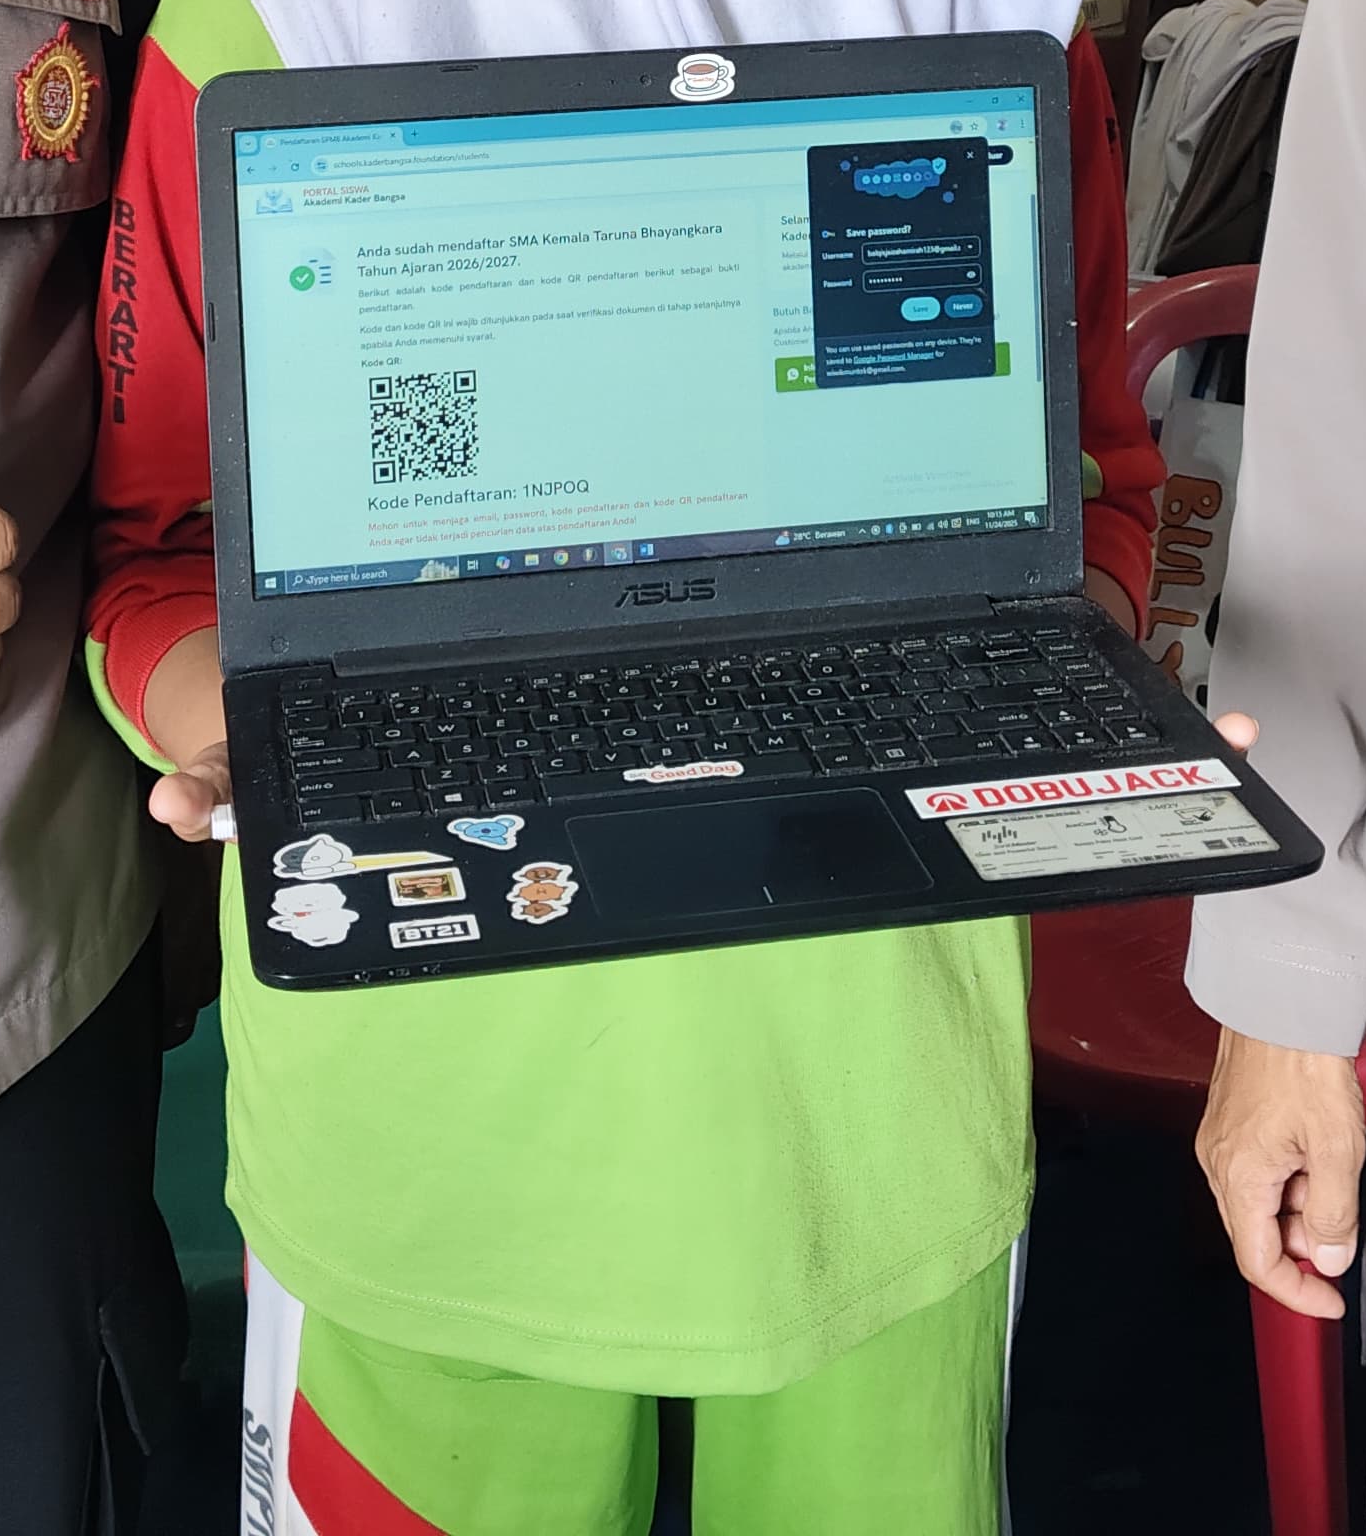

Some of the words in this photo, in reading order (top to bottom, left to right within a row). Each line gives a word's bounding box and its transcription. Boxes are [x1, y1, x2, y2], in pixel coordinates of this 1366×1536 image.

[303, 186, 339, 198] PORTAL
[341, 185, 370, 196] SISWA
[303, 196, 343, 207] Akademi
[344, 195, 371, 205] Kader
[373, 193, 406, 204] Bangsa
[357, 247, 391, 258] Anda
[395, 242, 434, 256] sudah
[437, 238, 506, 253] mendaftar
[509, 234, 539, 248] SMA
[542, 231, 590, 246] Kemala
[593, 229, 638, 242] Taruna
[640, 224, 723, 241] Bhayangkara
[846, 228, 866, 238] Save
[867, 225, 912, 240] password?
[821, 251, 854, 260] Username
[357, 264, 397, 278] Tahun
[401, 261, 444, 277] Ajaran
[447, 254, 522, 272] 2026/2027.
[358, 288, 390, 298] Berikut
[396, 286, 426, 296] adalah
[431, 284, 453, 293] kode
[459, 280, 513, 292] pendaftaran
[518, 278, 535, 287] dan
[540, 275, 562, 285] kode
[567, 274, 581, 283] QR
[587, 270, 639, 283] pendaftaran
[645, 268, 675, 278] berikut
[680, 265, 713, 276] sebagai
[718, 263, 740, 272] bukti
[823, 279, 853, 288] Password
[107, 198, 139, 425] BERARTI
[358, 303, 414, 315] pendaftaran.
[772, 307, 801, 317] Butuh
[952, 302, 974, 311] Never
[360, 325, 383, 334] Kode
[385, 323, 402, 332] dan
[403, 321, 426, 331] kode
[427, 320, 441, 329] QR
[443, 319, 454, 328] ini
[456, 317, 479, 329] wajib
[480, 314, 531, 327] ditunjukkan
[532, 312, 554, 323] pada
[556, 311, 575, 320] saat
[576, 308, 615, 318] verifikasi
[616, 305, 656, 315] dokumen
[657, 303, 666, 312] di
[667, 302, 692, 313] tahap
[693, 298, 741, 310] selanjutnya
[360, 340, 393, 351] apabila
[395, 338, 418, 347] Anda
[419, 335, 465, 345] memenuhi
[466, 333, 496, 343] syarat.
[361, 358, 384, 368] Kode
[386, 357, 403, 366] QR:
[367, 497, 410, 511] Kode
[414, 488, 518, 507] Pendaftaran:
[522, 479, 590, 498] 1NJPOQ
[368, 521, 399, 532] Mohon
[403, 520, 428, 529] untuk
[432, 516, 469, 527] menjaga
[473, 513, 499, 523] email,
[503, 509, 548, 521] password,
[551, 506, 573, 516] kode
[577, 502, 630, 514] pendaftaran
[634, 499, 650, 508] dan
[654, 497, 675, 507] kode
[679, 496, 693, 505] QR
[696, 492, 748, 504] pendaftaran
[369, 538, 392, 548] Anda
[395, 536, 413, 546] agar
[416, 533, 438, 543] tidak
[440, 530, 468, 542] terjadi
[470, 527, 514, 540] pencurian
[516, 525, 536, 535] data
[537, 525, 556, 533] atas
[558, 519, 611, 532] pendaftaran
[815, 529, 846, 539] Berawan
[309, 575, 329, 586] Type
[330, 573, 349, 583] here
[361, 569, 388, 580] search
[614, 577, 718, 609] ASUS
[650, 766, 697, 780] Good
[700, 764, 737, 775] Day
[972, 765, 1213, 808] DOBUJACK
[957, 818, 1000, 828] ASUS
[403, 923, 465, 940] BT21
